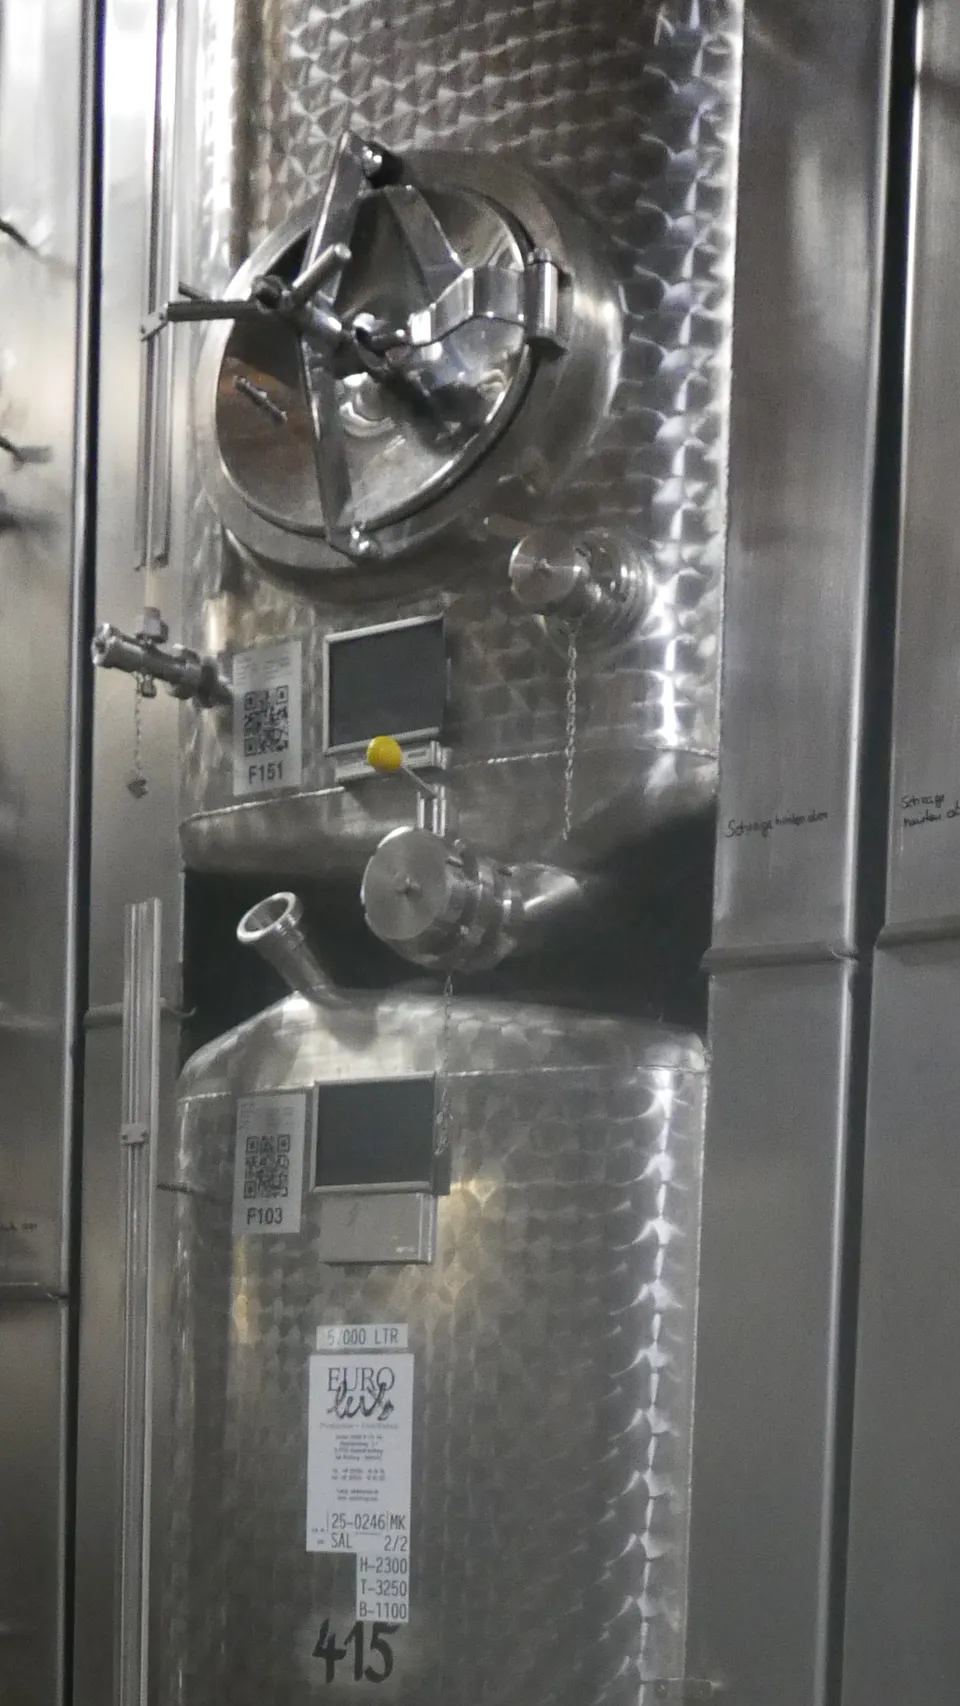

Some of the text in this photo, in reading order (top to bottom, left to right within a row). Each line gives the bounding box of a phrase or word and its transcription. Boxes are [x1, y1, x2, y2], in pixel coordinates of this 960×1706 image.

[248, 760, 283, 784] F151
[246, 1207, 283, 1225] F103
[374, 1327, 398, 1345] LTR
[327, 1366, 395, 1392] EURO
[331, 1513, 406, 1530] 25-0246 MK
[330, 1532, 408, 1552] SAL 2/2
[359, 1556, 408, 1574] H-2300
[360, 1579, 407, 1597] T-3250
[359, 1601, 407, 1619] B-1100
[312, 1618, 400, 1683] 415
